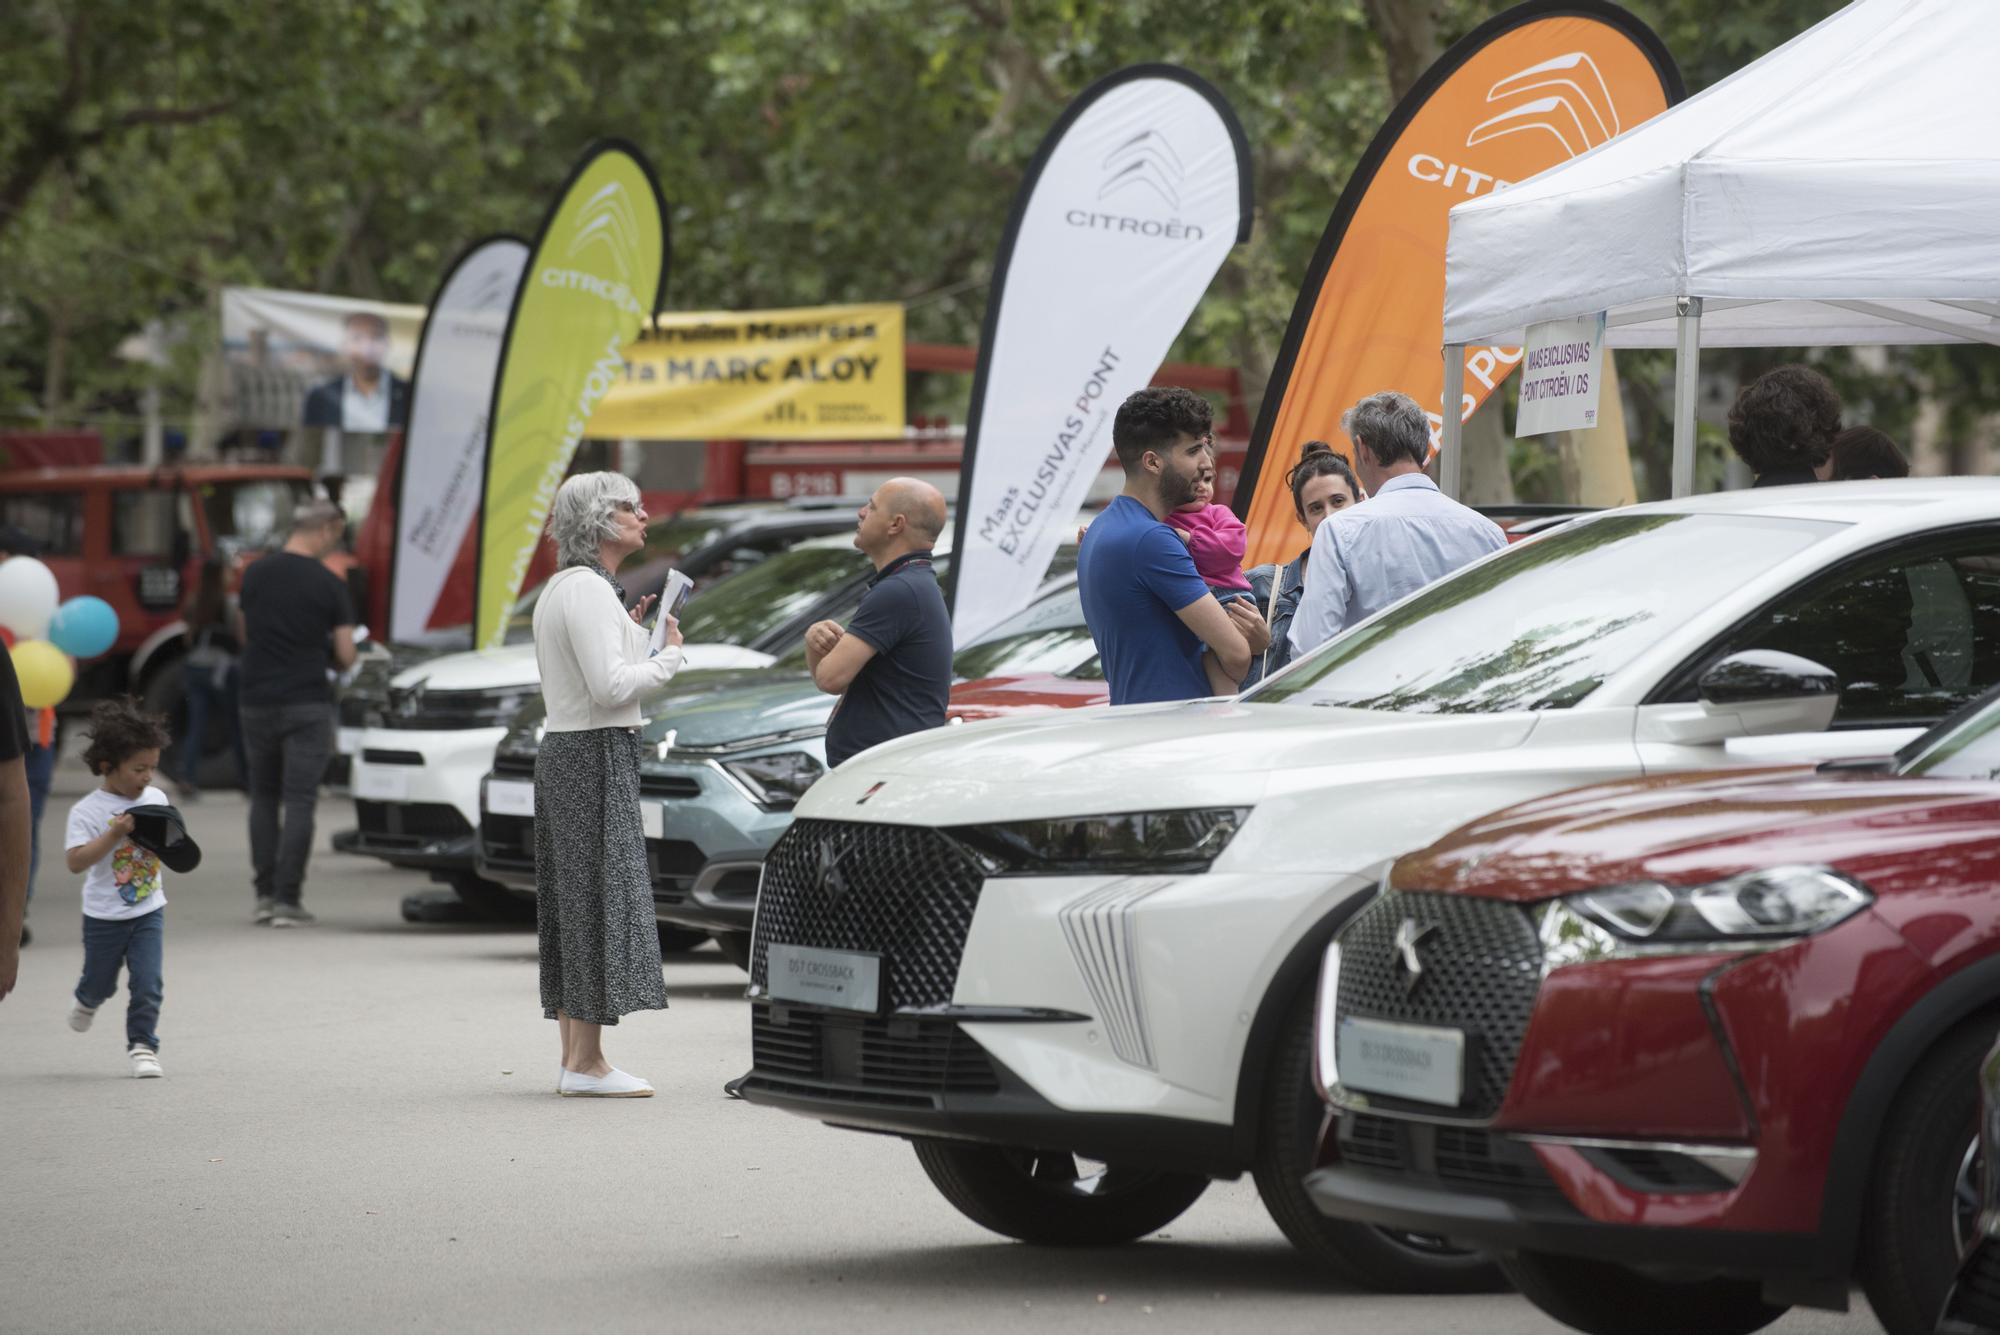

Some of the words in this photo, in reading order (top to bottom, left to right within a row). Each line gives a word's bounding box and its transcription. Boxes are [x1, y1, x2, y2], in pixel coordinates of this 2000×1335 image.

[666, 357, 773, 383] MARC
[782, 353, 880, 383] ALOY
[1527, 349, 1543, 370] MAAS
[1543, 341, 1590, 368] EXCLUSIVAS
[1524, 380, 1540, 403] PONT
[1539, 371, 1571, 399] CITROËN
[1576, 373, 1589, 395] DS
[998, 415, 1085, 557] EXCLUSIVAS
[1075, 345, 1121, 415] PONT
[979, 484, 1020, 543] Maas
